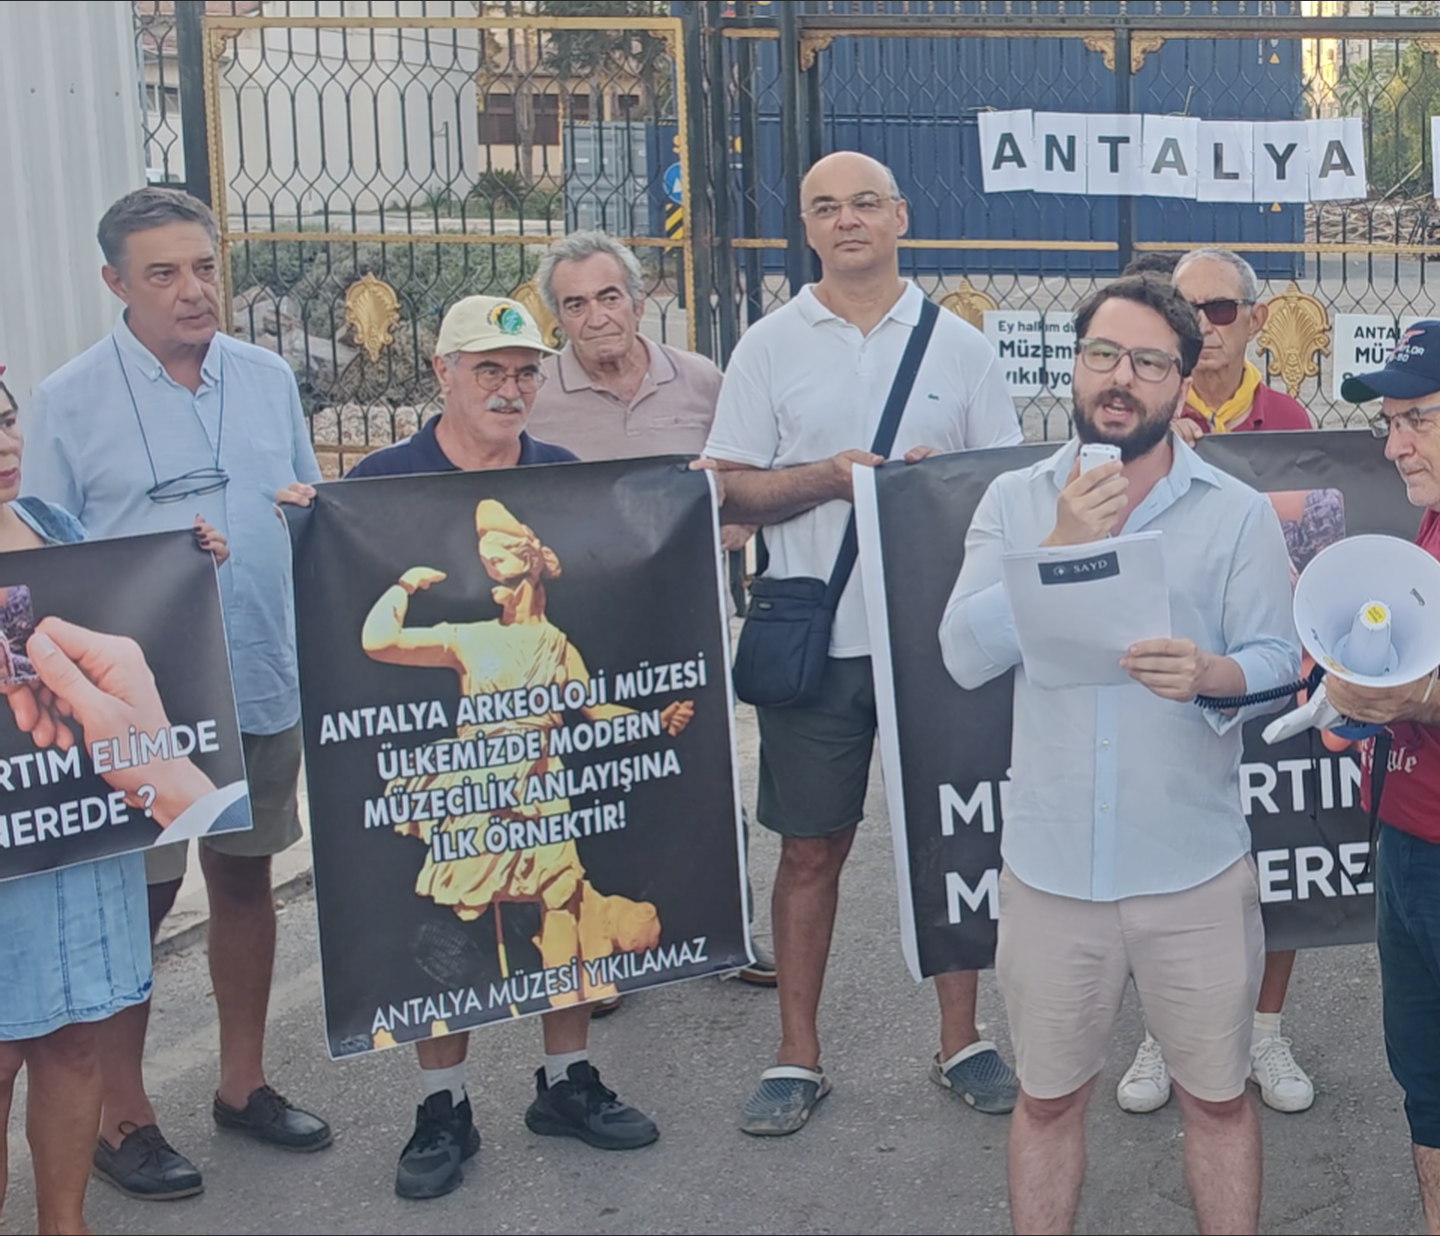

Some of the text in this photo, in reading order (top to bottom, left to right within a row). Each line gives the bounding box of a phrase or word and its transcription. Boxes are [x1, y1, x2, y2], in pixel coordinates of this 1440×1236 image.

[991, 131, 1356, 180] ANTALYA
[998, 320, 1014, 334] Ey
[1073, 559, 1108, 574] SAYD
[319, 652, 707, 745] ANTALYA ARKEOLOJİ MÜZESİ
[91, 720, 220, 775] ELİMDE
[376, 709, 662, 780] ÜLKEMİZDE MODERN
[137, 783, 157, 819] ?
[363, 748, 681, 829] MÜZECİLİK ANLAYIŞINA
[430, 800, 627, 864] İLK ÖRNEKTİR!
[371, 936, 708, 1034] ANTALYA MÜZESİ YIKILAMAZ
